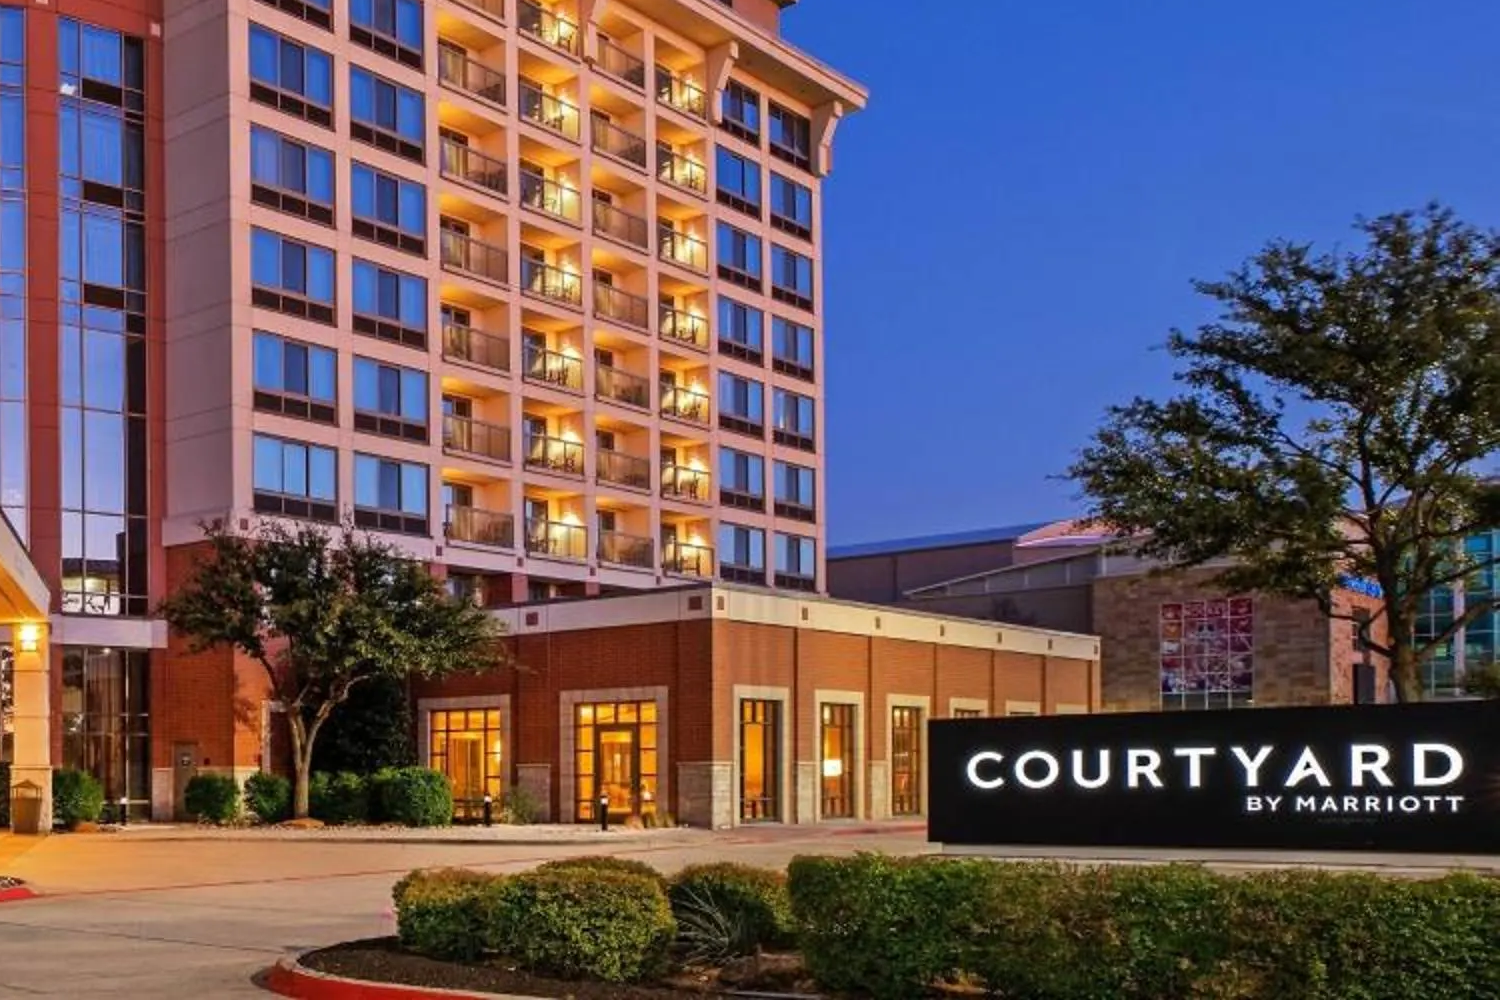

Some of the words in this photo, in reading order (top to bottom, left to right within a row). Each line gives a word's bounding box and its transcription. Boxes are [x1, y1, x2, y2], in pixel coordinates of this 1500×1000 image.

[966, 743, 1464, 789] COURTYARD
[1246, 796, 1281, 812] BY
[1296, 796, 1464, 813] MARRIOTT
